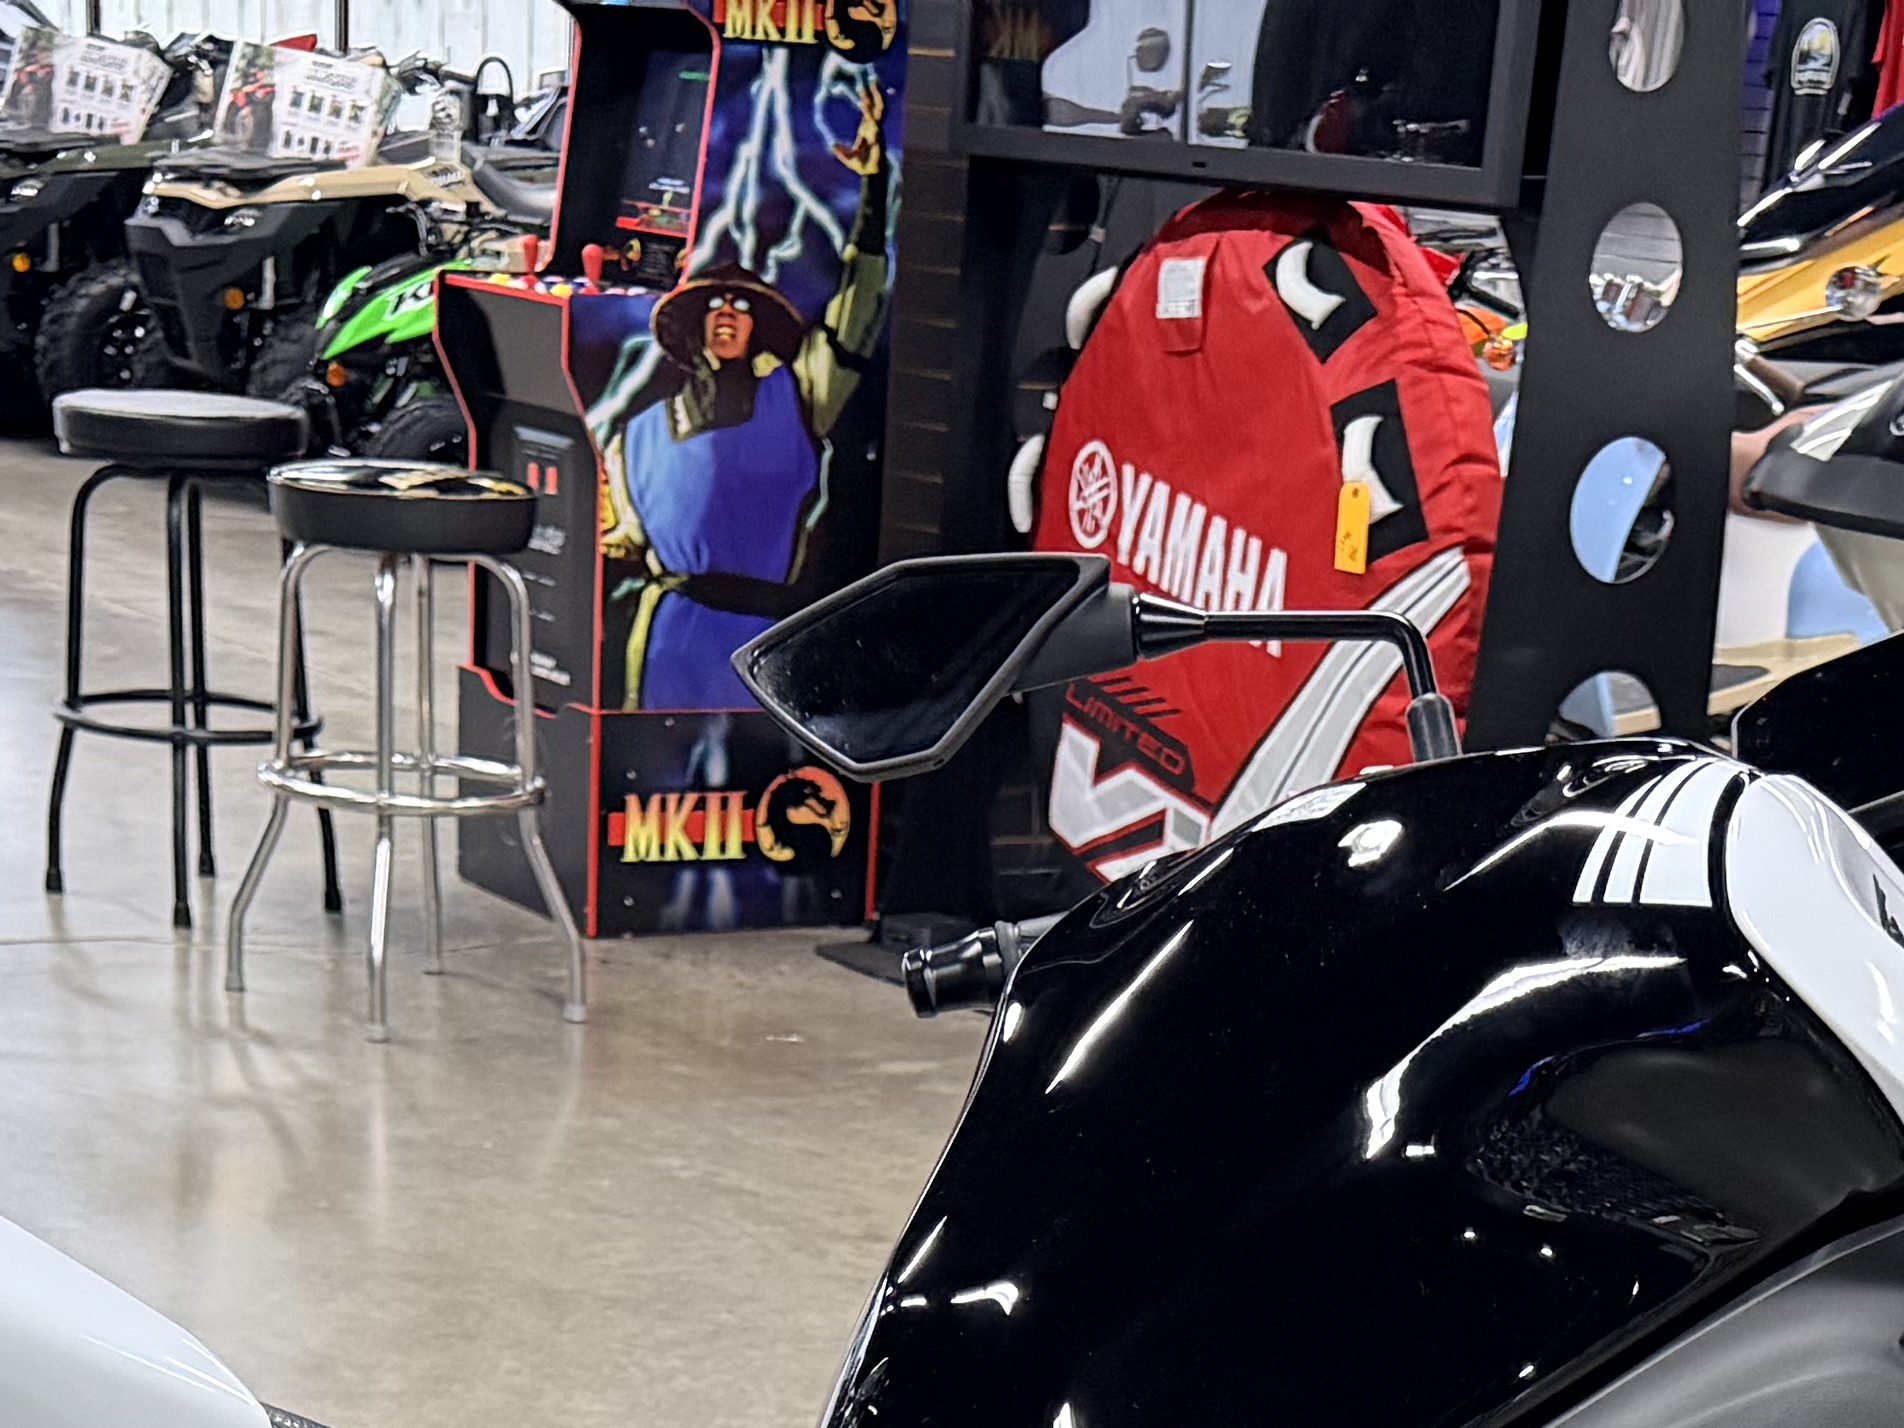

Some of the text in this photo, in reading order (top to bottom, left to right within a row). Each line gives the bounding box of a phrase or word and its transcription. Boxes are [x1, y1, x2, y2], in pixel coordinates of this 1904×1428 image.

[1117, 462, 1288, 659] YAMAHA
[1065, 683, 1186, 776] LIMITED
[620, 790, 748, 863] MKII
